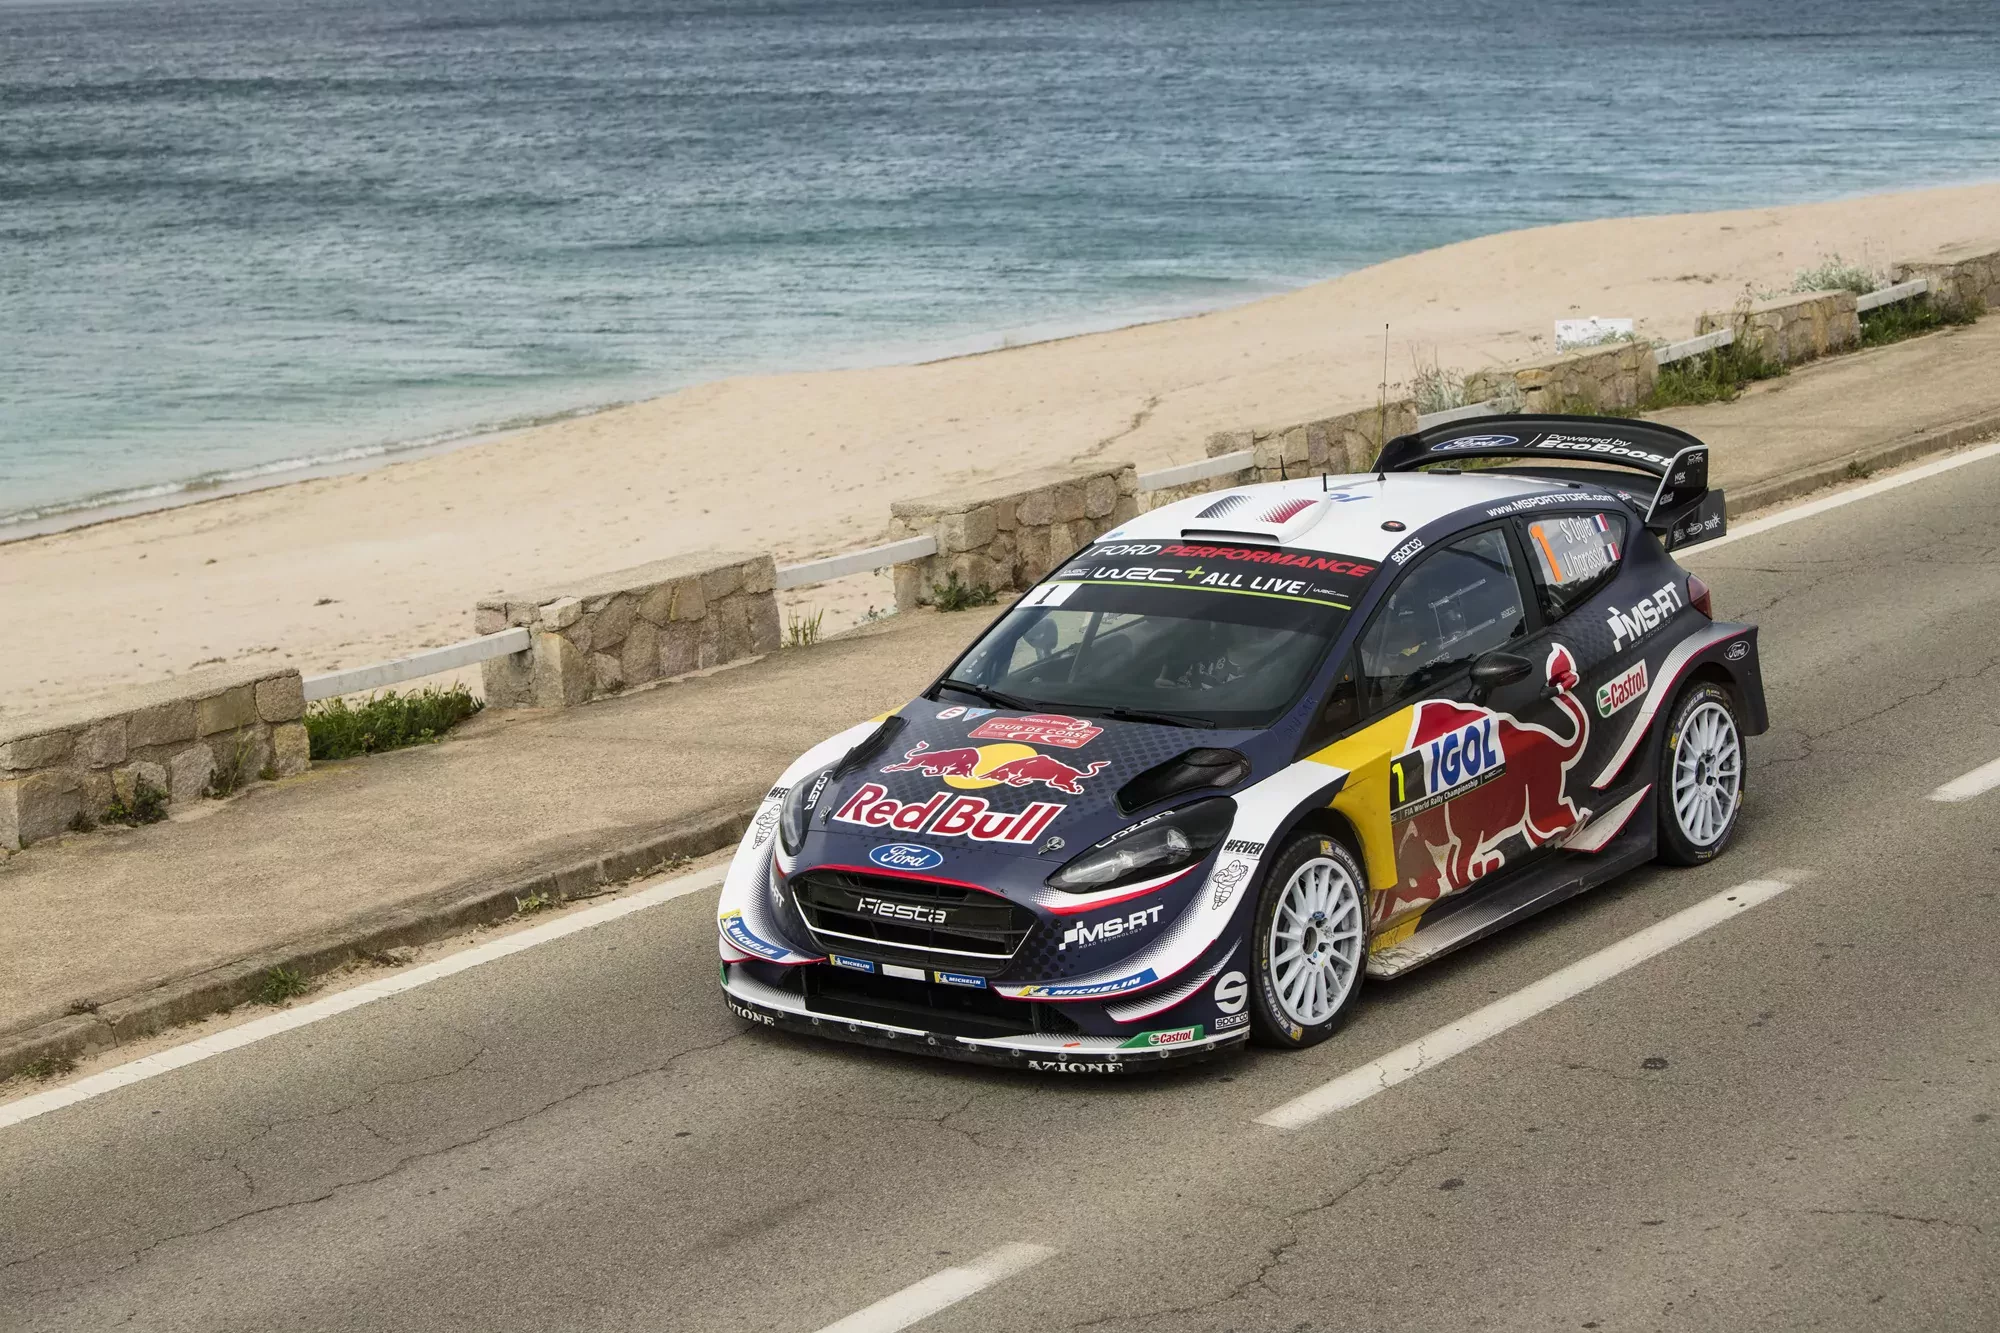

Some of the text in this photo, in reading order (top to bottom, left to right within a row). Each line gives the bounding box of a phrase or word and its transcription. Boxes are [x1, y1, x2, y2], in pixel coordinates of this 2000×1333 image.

[1445, 435, 1504, 449] Ford
[1546, 433, 1632, 447] Powered by
[1536, 440, 1673, 468] EcoBoost
[1486, 492, 1615, 517] www.MSPORTSTORE.com
[1559, 516, 1595, 544] S Ogier
[1090, 544, 1375, 577] FORD PERFORMANCE
[1391, 538, 1422, 563] sparco
[1530, 524, 1563, 583] 1
[1562, 544, 1608, 578] J Ingrassia
[1034, 584, 1060, 605] 1
[1200, 572, 1243, 588] ALL
[1250, 576, 1307, 595] LIVE
[1610, 665, 1646, 709] Castrol
[988, 723, 1023, 731] TOUR
[1046, 728, 1092, 739] CORSE
[1430, 718, 1497, 794] IGOL
[1391, 762, 1406, 803] 1
[1404, 806, 1414, 817] FIA
[1414, 800, 1429, 812] World
[1430, 795, 1444, 806] Rally
[1444, 779, 1479, 800] Championship
[834, 783, 1063, 842] Red Bull
[880, 845, 930, 867] Ford
[1223, 838, 1266, 855] #FEVER
[857, 896, 947, 924] Fiesta
[730, 926, 778, 956] MICHELIN
[1099, 927, 1143, 944] TECHNOLOGY
[842, 959, 870, 970] MICHELIN
[948, 976, 981, 985] MICHELIN
[1051, 976, 1142, 995] MICHELIN
[1216, 1012, 1248, 1028] sparco
[1159, 1029, 1192, 1045] Castrol
